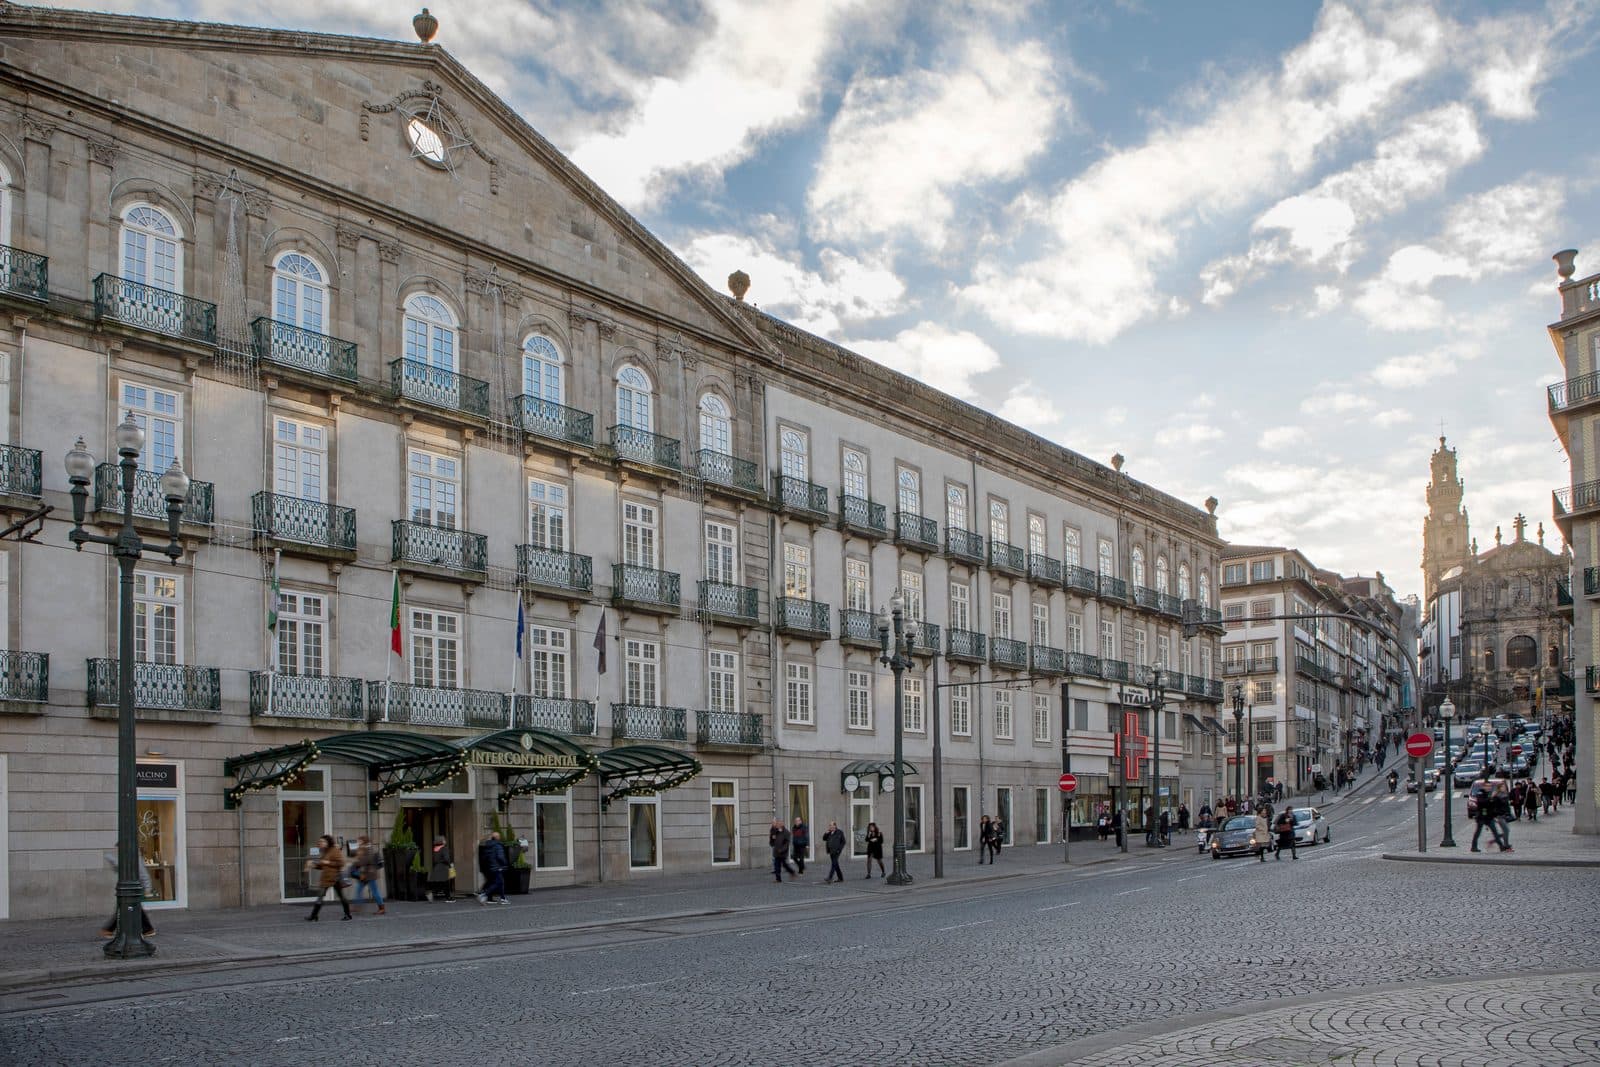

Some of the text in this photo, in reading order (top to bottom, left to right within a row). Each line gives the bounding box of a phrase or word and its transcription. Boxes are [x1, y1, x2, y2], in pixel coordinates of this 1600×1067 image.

[1117, 691, 1150, 705] VITALI
[471, 750, 579, 767] INTERCONTINENTAL
[136, 771, 168, 779] ALCINO
